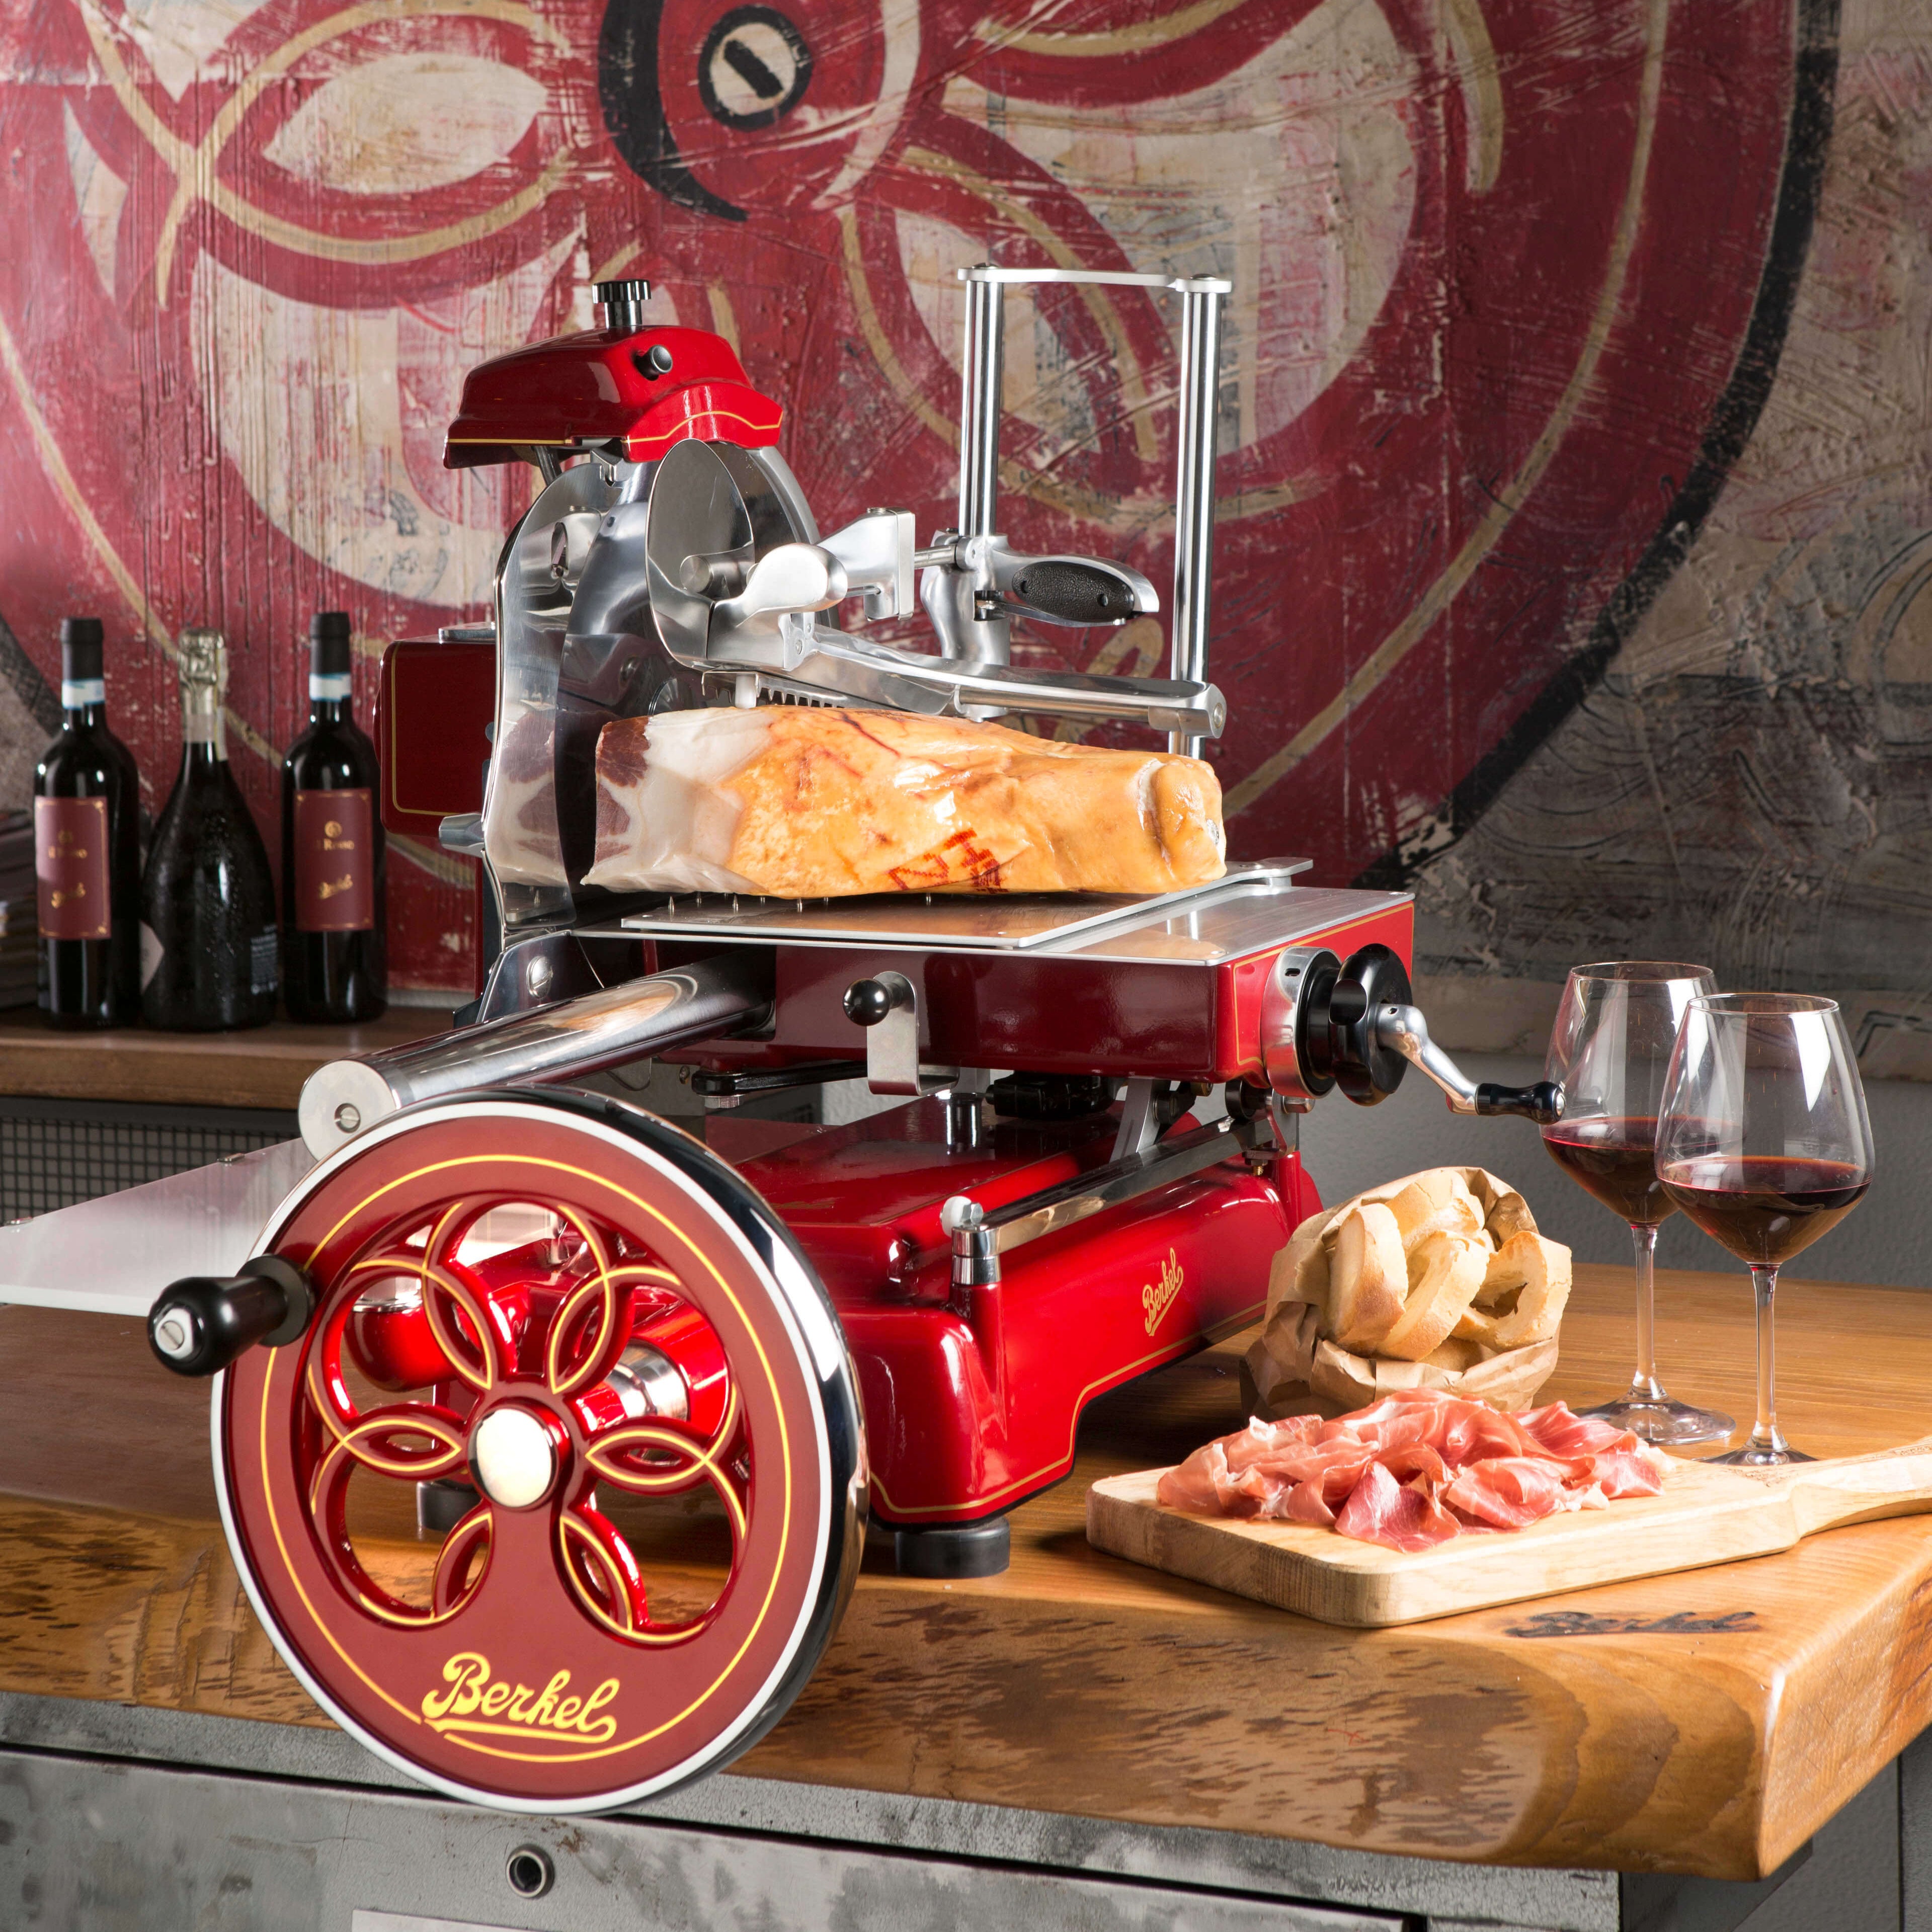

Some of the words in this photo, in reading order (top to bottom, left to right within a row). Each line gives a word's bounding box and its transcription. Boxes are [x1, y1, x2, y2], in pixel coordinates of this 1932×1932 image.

[1142, 1247, 1184, 1337] Berkel
[1501, 1611, 1762, 1638] Berkel
[421, 1651, 620, 1744] Berkel
